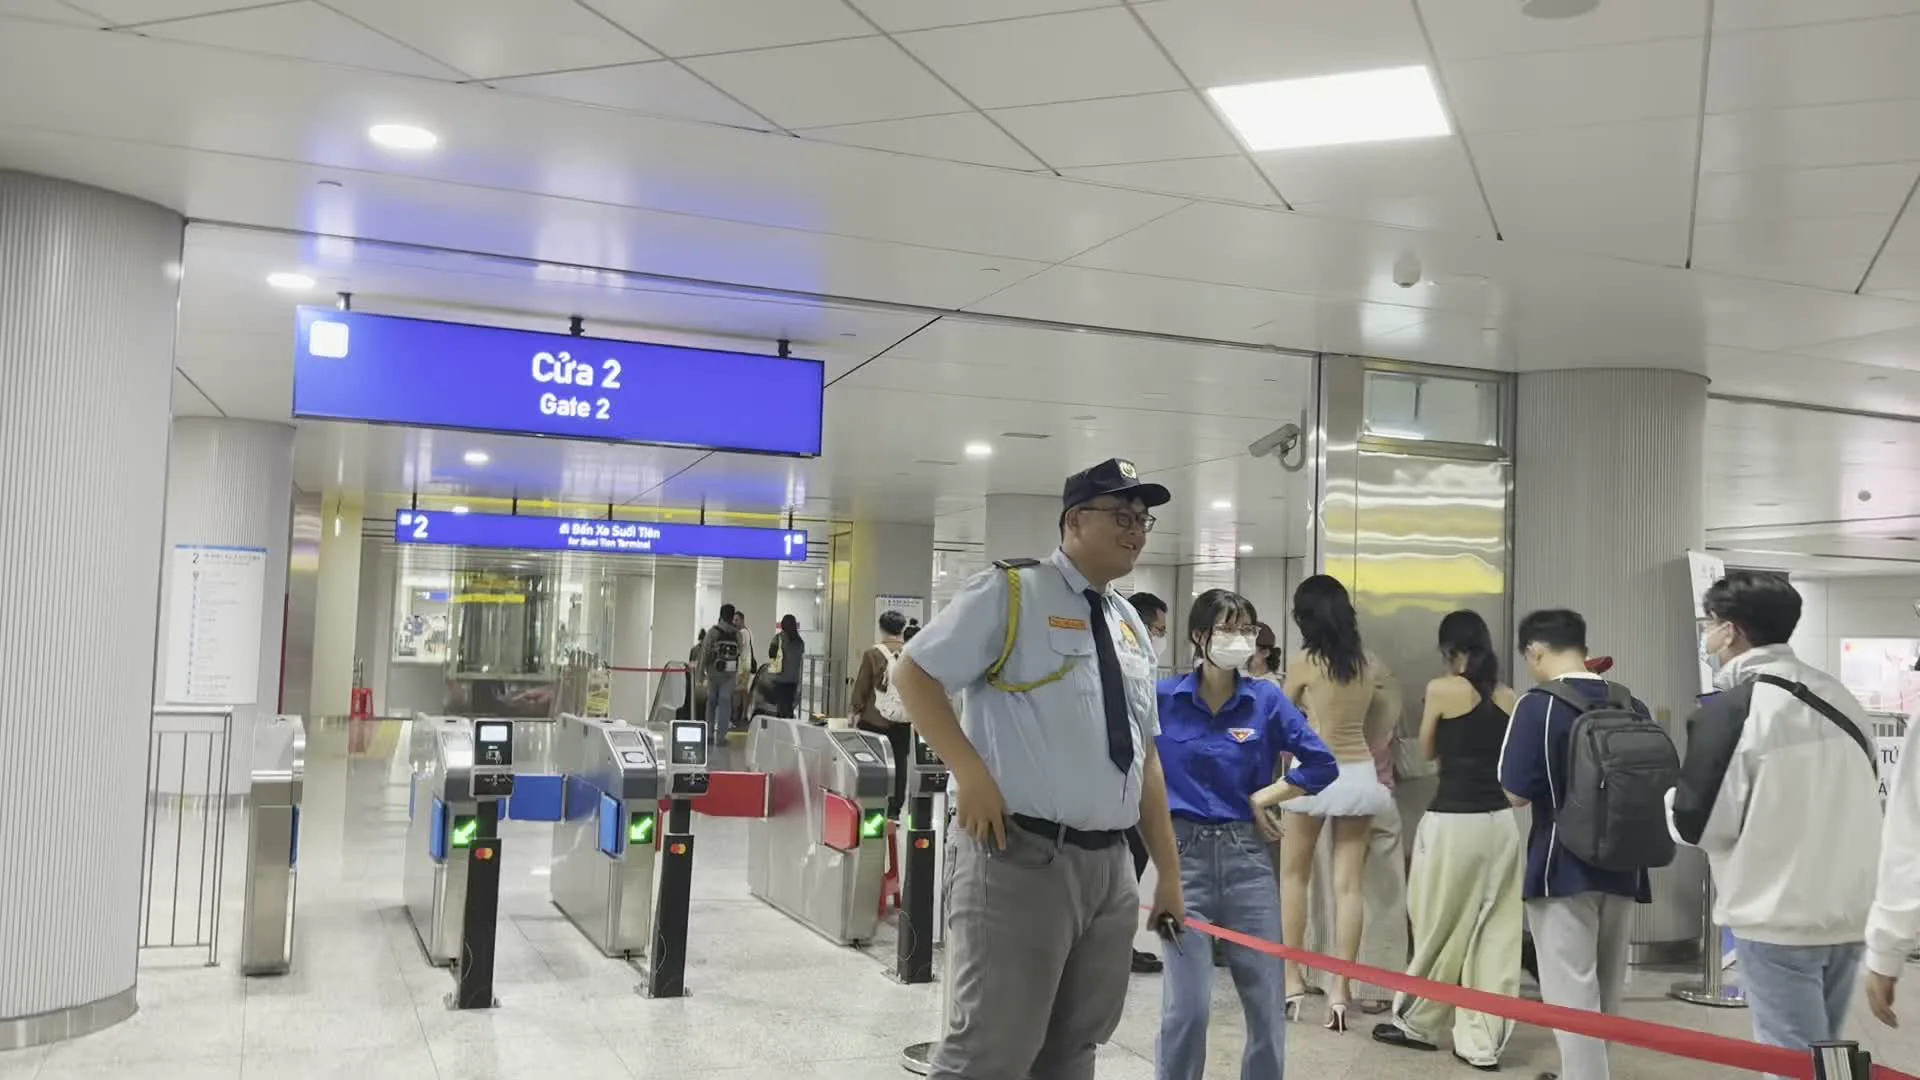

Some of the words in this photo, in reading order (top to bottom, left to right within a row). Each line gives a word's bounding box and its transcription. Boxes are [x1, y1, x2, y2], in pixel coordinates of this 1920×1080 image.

[532, 351, 594, 387] Cửa
[601, 358, 621, 389] 2
[540, 392, 591, 418] Gate
[595, 397, 611, 420] 2
[413, 514, 429, 539] 2
[783, 534, 792, 556] 1
